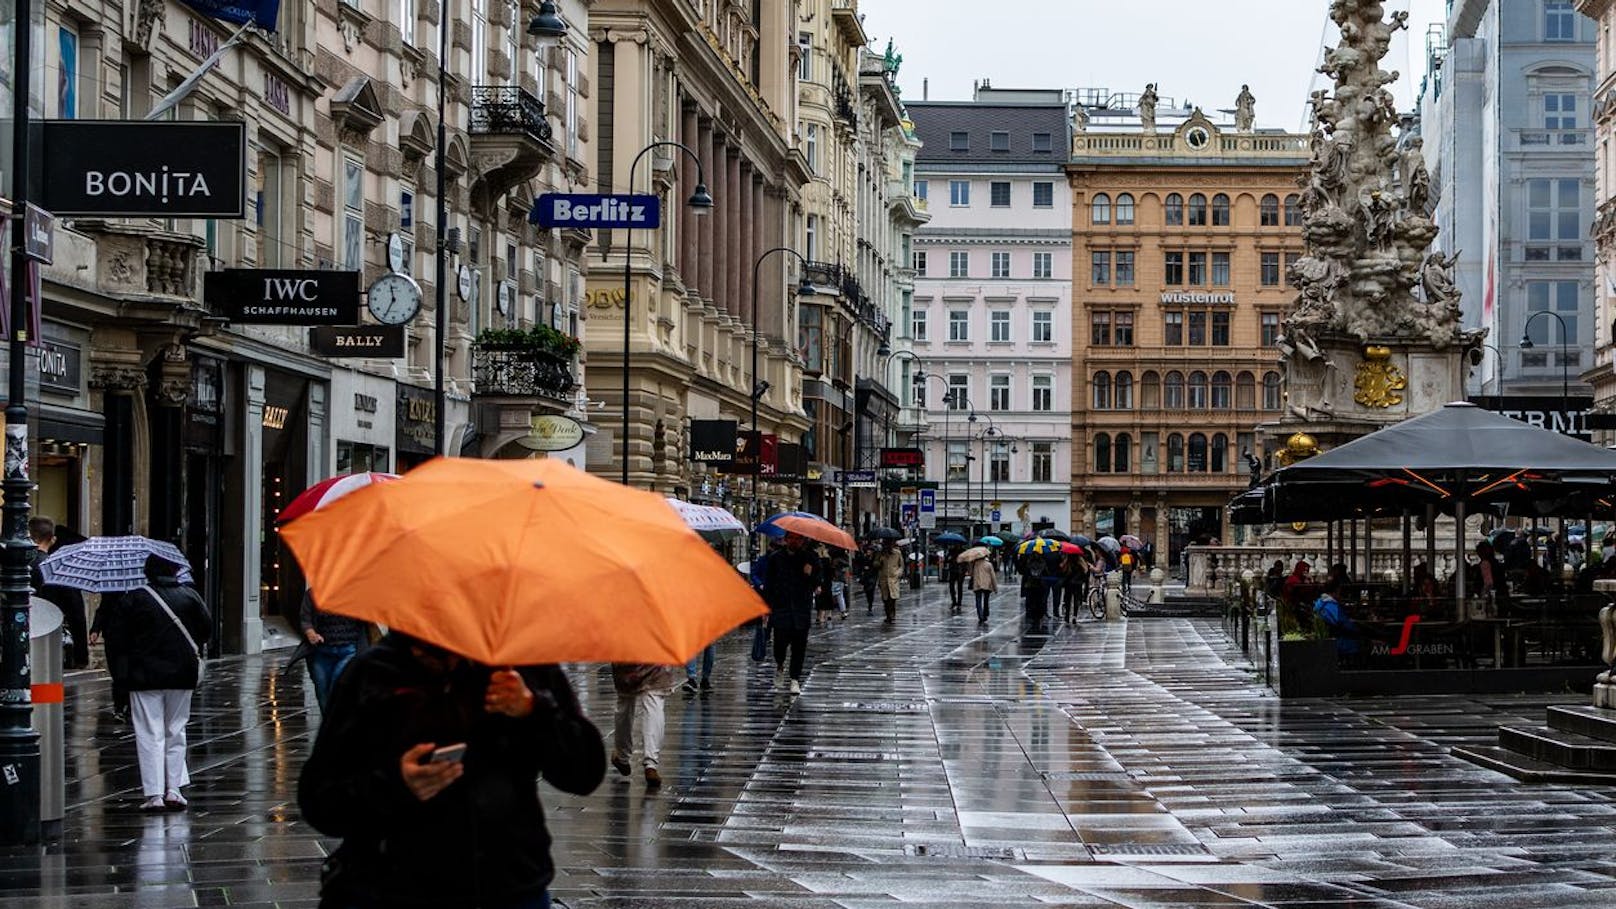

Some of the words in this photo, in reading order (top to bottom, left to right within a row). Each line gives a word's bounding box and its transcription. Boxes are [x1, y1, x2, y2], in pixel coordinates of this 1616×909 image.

[553, 198, 646, 222] Berlitz
[264, 278, 318, 301] IWC
[243, 306, 337, 316] SCHAFFHAUSEN
[336, 336, 384, 346] BALLY
[694, 450, 732, 461] MaxMara
[1370, 645, 1391, 656] AM
[1406, 643, 1454, 656] GRABEN
